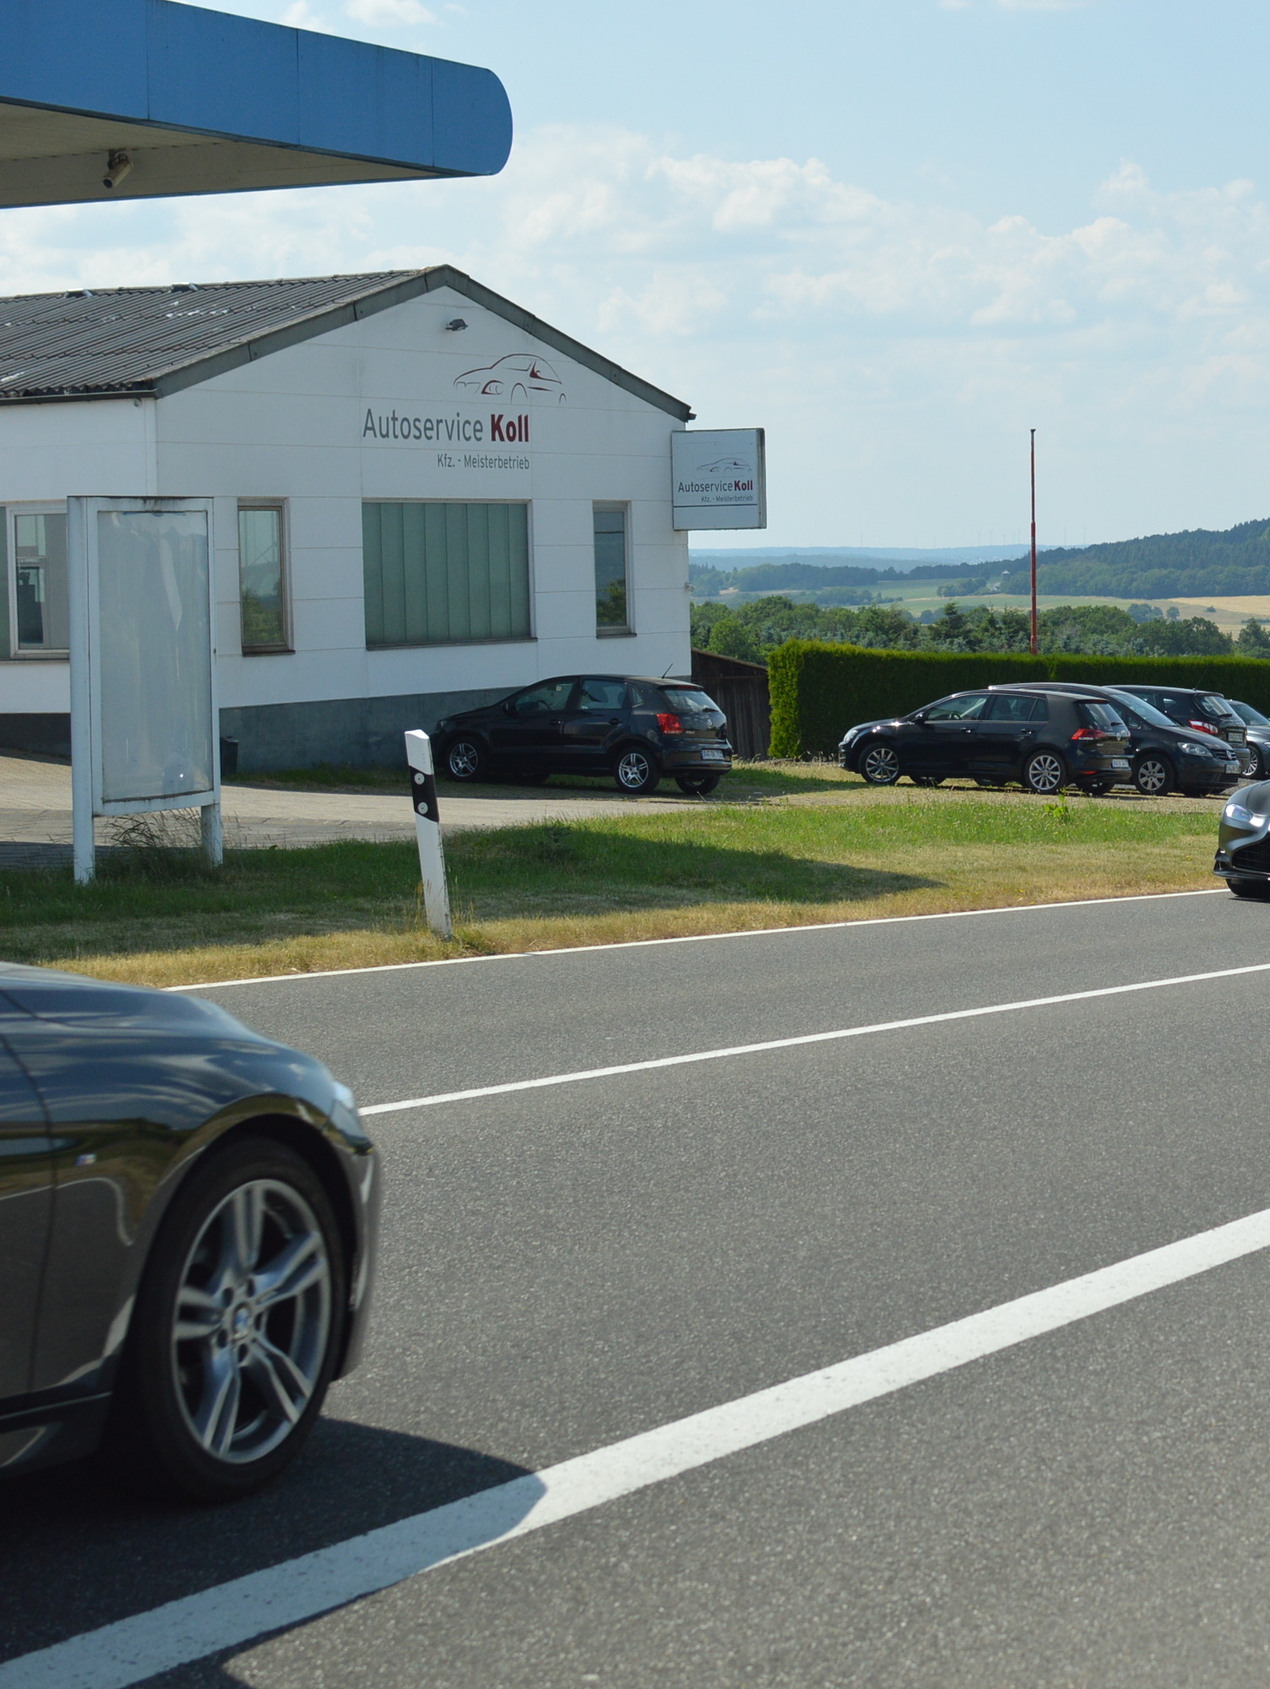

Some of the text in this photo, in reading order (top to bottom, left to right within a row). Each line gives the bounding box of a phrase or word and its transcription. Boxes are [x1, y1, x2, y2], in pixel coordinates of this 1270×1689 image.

[363, 408, 529, 442] Autoservice Koll
[437, 454, 455, 468] Kfz.
[464, 454, 530, 470] Meisterbetrieb
[678, 480, 753, 492] Autoservice Koll
